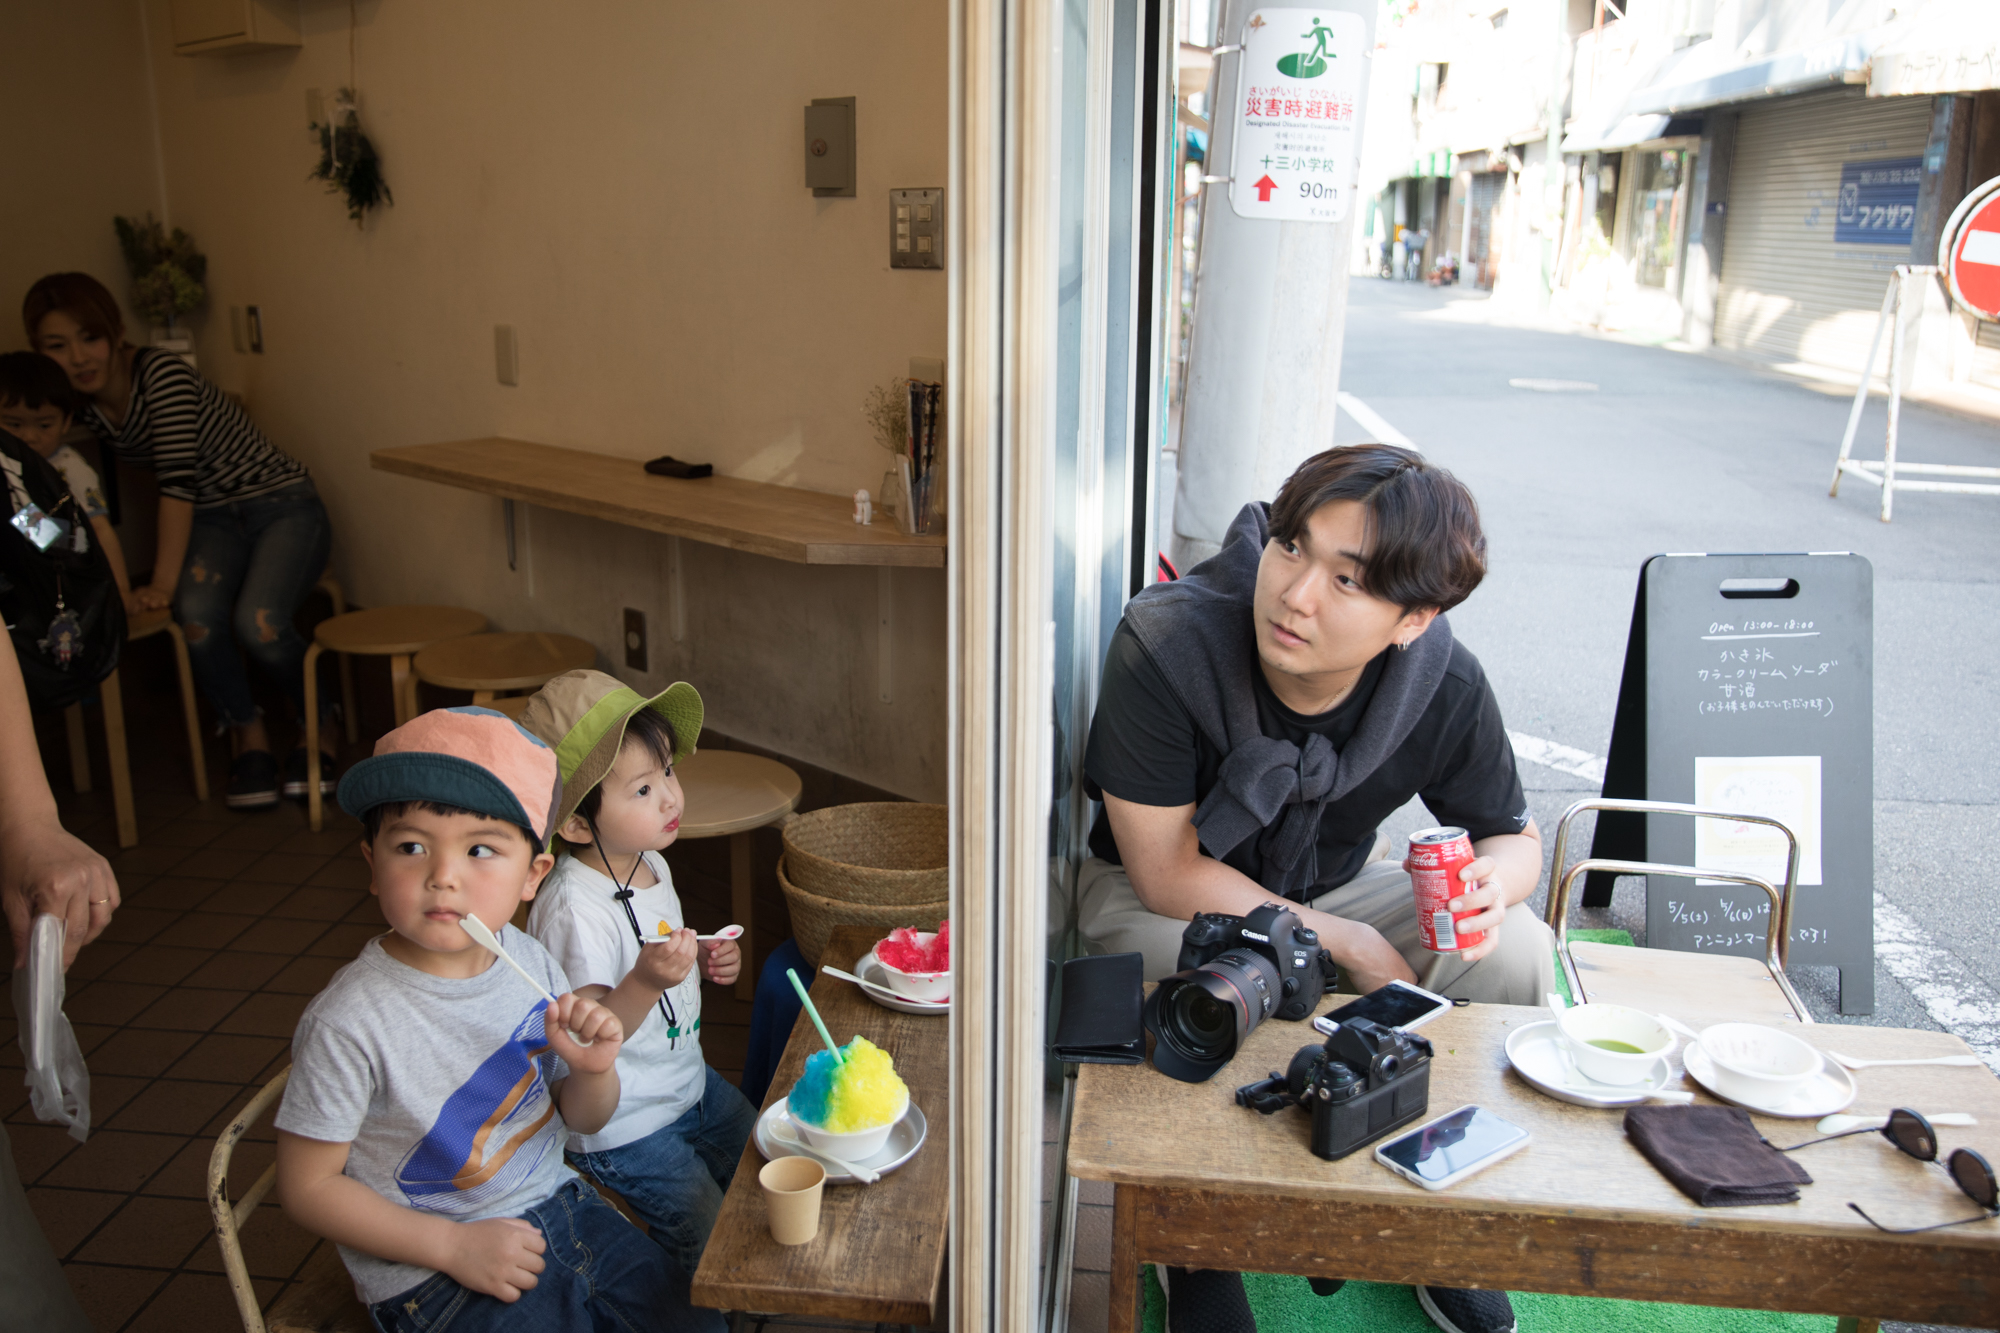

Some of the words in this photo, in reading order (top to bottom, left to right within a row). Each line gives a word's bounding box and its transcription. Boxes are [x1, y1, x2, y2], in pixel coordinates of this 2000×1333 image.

[1249, 85, 1302, 98] さいがいじ
[1245, 97, 1353, 122] 災害時避難所
[1245, 119, 1281, 128] Designated
[1282, 120, 1309, 129] Disaster
[1310, 122, 1341, 131] Evacuation
[1260, 154, 1335, 173] 十三小学校
[1300, 182, 1337, 199] 90m
[1858, 204, 1914, 230] フクザワ
[1709, 621, 1735, 634] Open
[1720, 648, 1774, 663] かき氷
[1719, 682, 1755, 698] 甘酒
[1241, 928, 1270, 943] Canon
